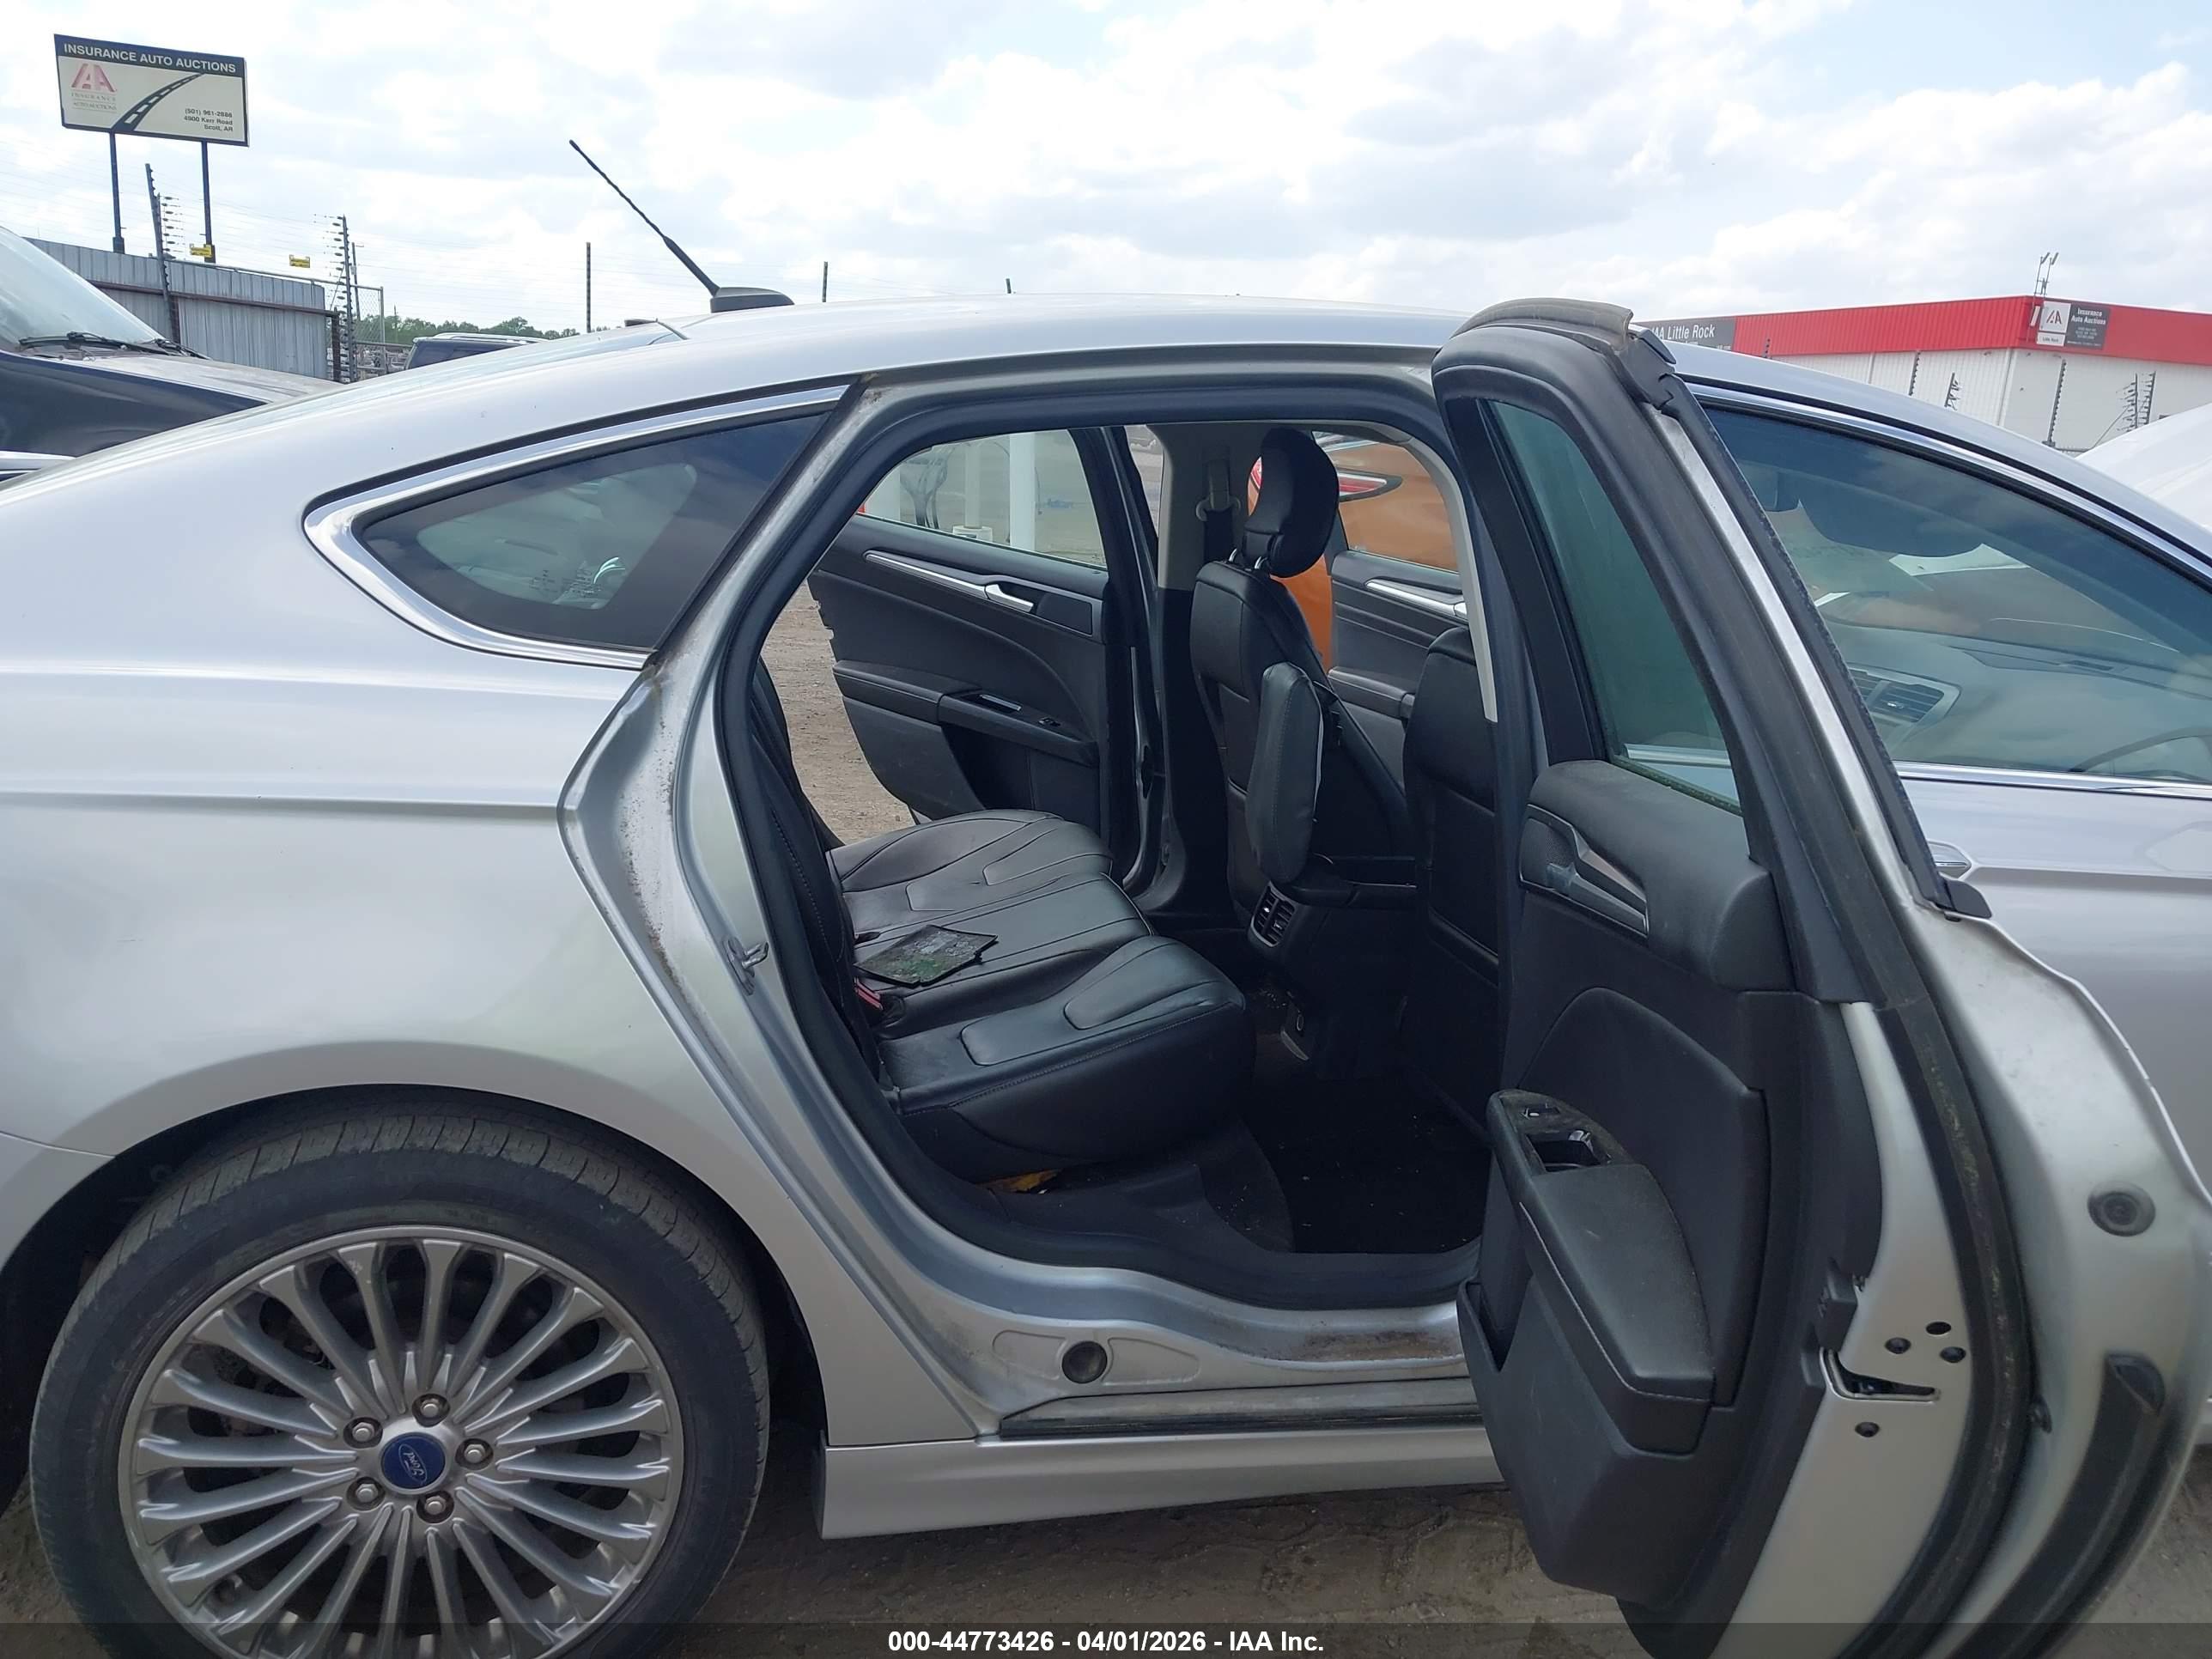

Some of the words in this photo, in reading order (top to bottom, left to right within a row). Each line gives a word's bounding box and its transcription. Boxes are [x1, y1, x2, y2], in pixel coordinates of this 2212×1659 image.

[64, 43, 137, 62] INSURANCE
[140, 53, 173, 65] AUTO
[175, 58, 236, 73] AUCTIONS
[185, 107, 202, 116] (501)
[2077, 307, 2102, 317] Insurance
[2070, 314, 2083, 323] Auto
[2084, 315, 2106, 325] Auctions
[1667, 325, 1690, 340] Little
[1692, 324, 1716, 339] Rock
[403, 1452, 425, 1476] Ford
